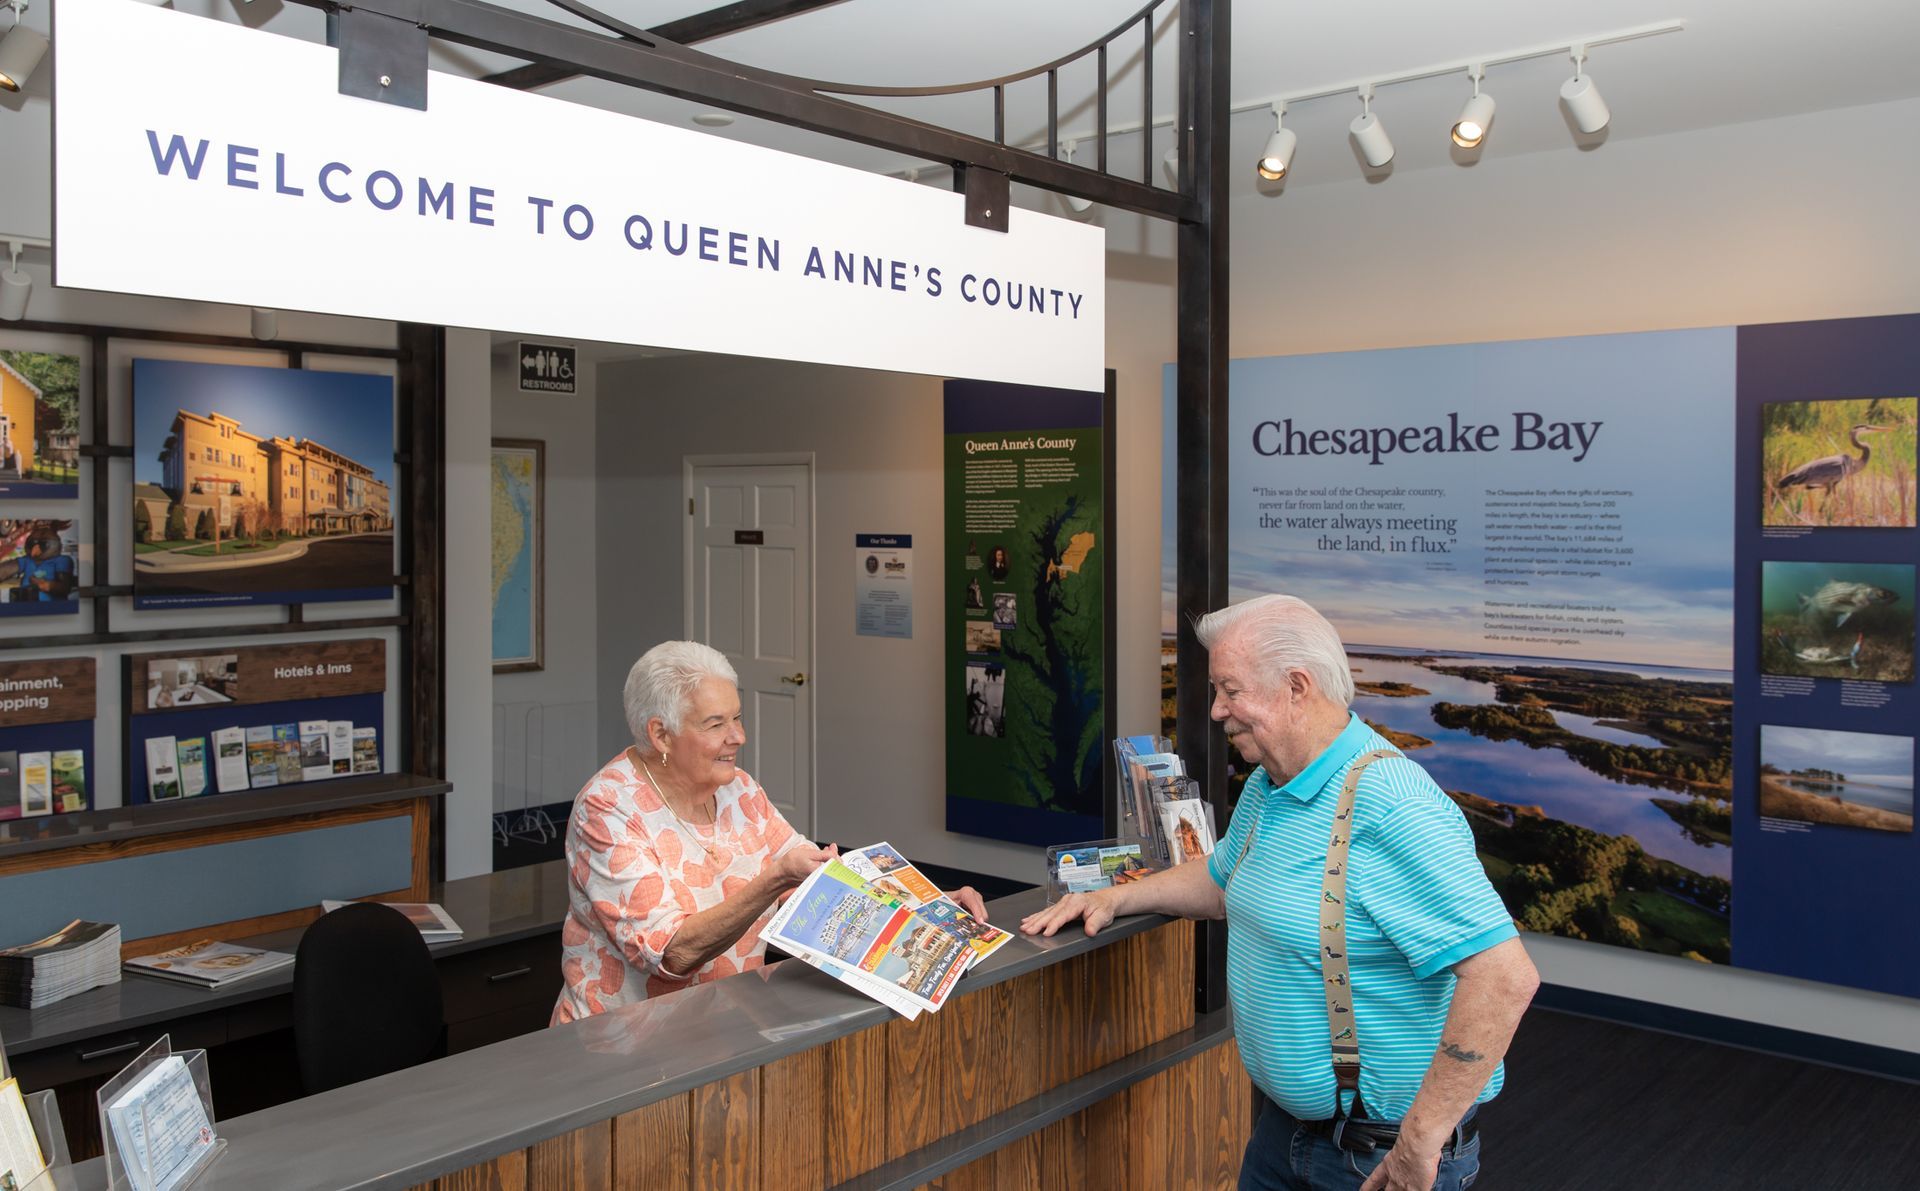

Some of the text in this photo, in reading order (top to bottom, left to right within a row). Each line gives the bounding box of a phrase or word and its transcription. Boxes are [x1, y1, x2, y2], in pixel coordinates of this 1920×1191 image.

[146, 129, 1083, 319] WELCOME TO QUEEN ANNE'S COUNTY
[522, 379, 574, 391] RESTROOMS
[965, 437, 1077, 454] Queen Anne's County
[1252, 412, 1603, 465] Chesapeake Bay
[1295, 488, 1308, 496] the
[1310, 488, 1326, 496] soul
[1328, 488, 1338, 496] of
[1339, 488, 1353, 496] the
[1355, 488, 1407, 498] Chesapeake
[1285, 501, 1297, 510] far
[1299, 501, 1321, 510] from
[1324, 501, 1344, 510] land
[1360, 501, 1374, 510] the
[1377, 502, 1404, 511] water,
[1259, 513, 1457, 535] the water always meeting
[1318, 535, 1341, 551] the
[1346, 535, 1386, 553] land,
[1390, 537, 1406, 552] in
[274, 662, 352, 680] Hotels & Inns
